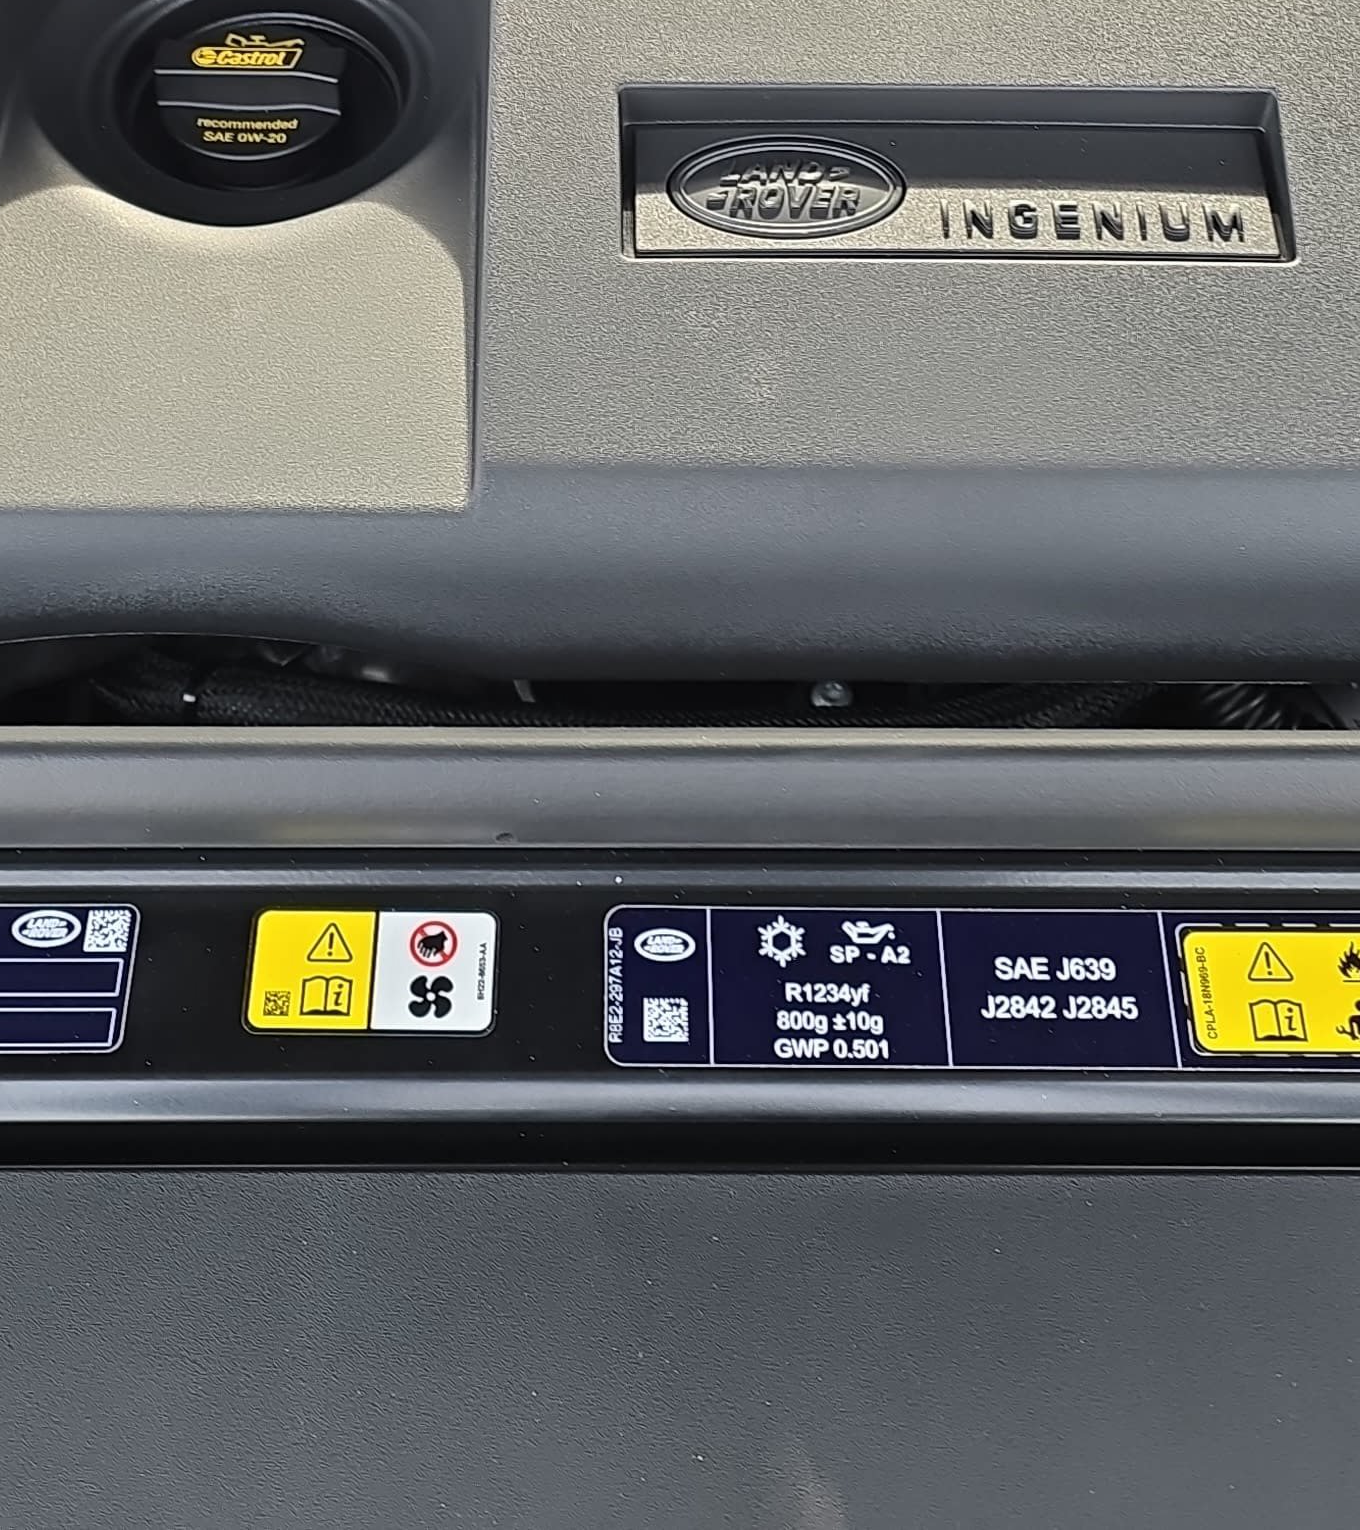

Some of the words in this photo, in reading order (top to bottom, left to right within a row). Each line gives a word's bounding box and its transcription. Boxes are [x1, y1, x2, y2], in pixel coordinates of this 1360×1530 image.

[217, 50, 286, 66] Castrol
[196, 118, 299, 131] recommended
[203, 131, 234, 144] SAE
[237, 131, 288, 144] 0W-20
[720, 159, 826, 187] LAND
[729, 185, 862, 220] ROVER
[942, 197, 1247, 243] INGENIUM
[829, 945, 861, 964] SP
[880, 945, 911, 964] A2
[994, 956, 1050, 981] SAE
[1056, 957, 1116, 982] J639
[608, 926, 624, 1044] R8E2-297A12-JB
[784, 982, 871, 1008] R1234yf
[980, 995, 1057, 1019] J2842
[1062, 996, 1139, 1021] J2845
[776, 1010, 829, 1035] 800g
[832, 1010, 884, 1036] ±10g
[773, 1037, 830, 1059] GWP
[833, 1037, 889, 1060] 0.501
